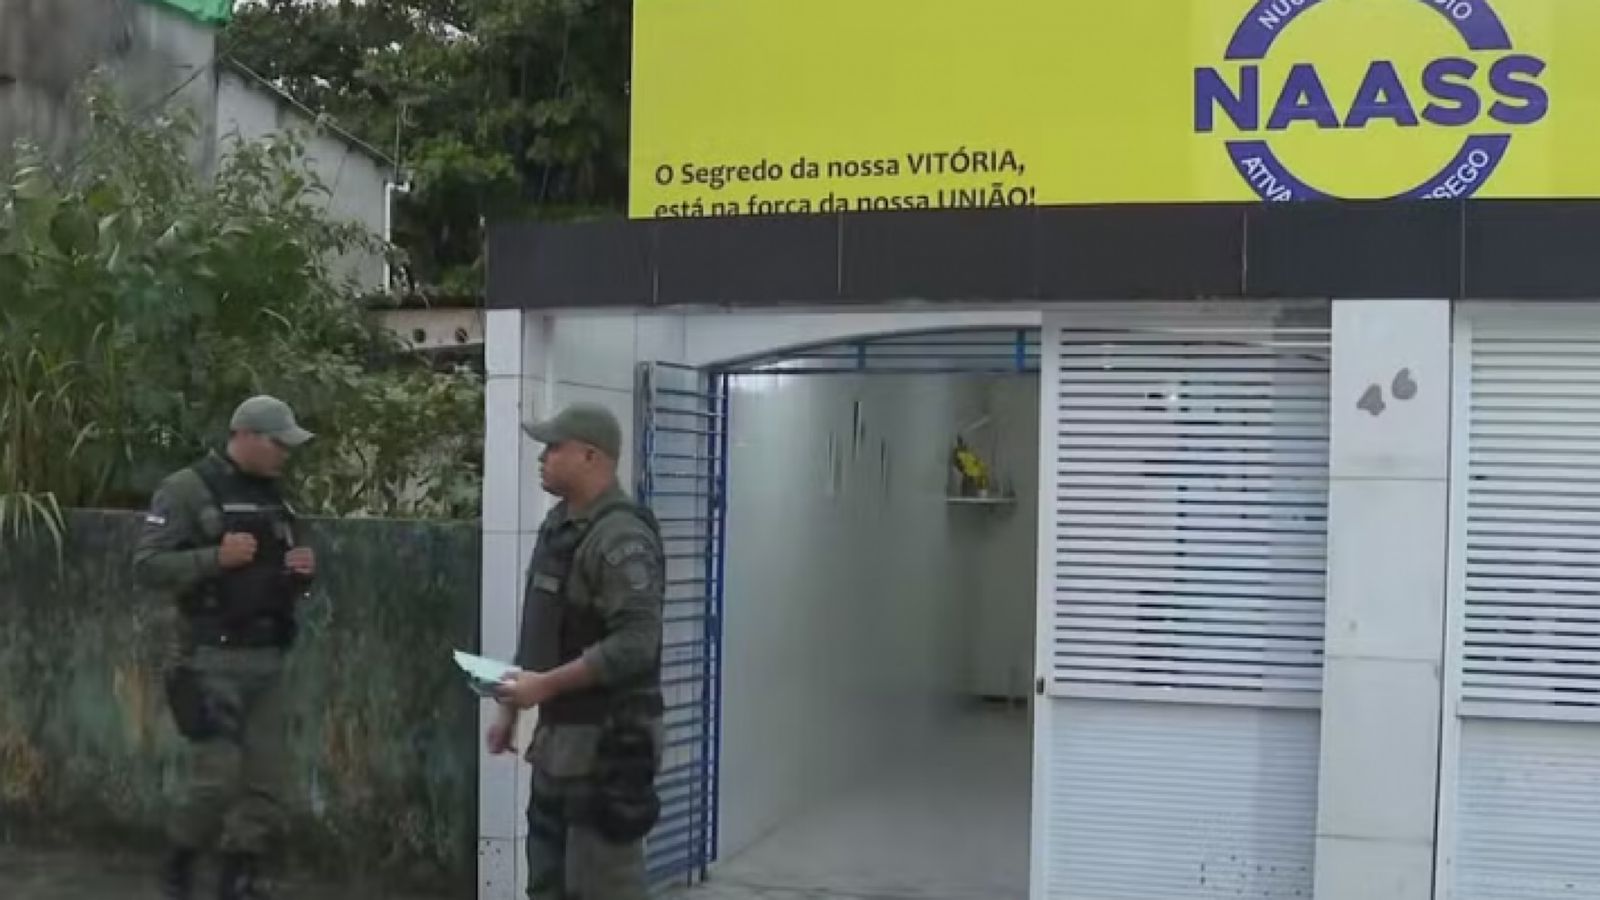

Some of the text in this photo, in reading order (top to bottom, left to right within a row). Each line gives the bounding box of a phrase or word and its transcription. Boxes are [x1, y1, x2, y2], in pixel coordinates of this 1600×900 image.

[1259, 0, 1305, 30] NU
[1194, 54, 1549, 133] NAASS
[655, 146, 1026, 190] O Segredo da nossa VITÓRIA,
[1421, 150, 1489, 199] SEGO
[655, 196, 704, 217] está
[711, 201, 740, 216] na
[820, 191, 850, 213] da
[857, 195, 930, 212] nossa
[937, 182, 1036, 209] UNIÃO!
[1356, 367, 1418, 416] 46
